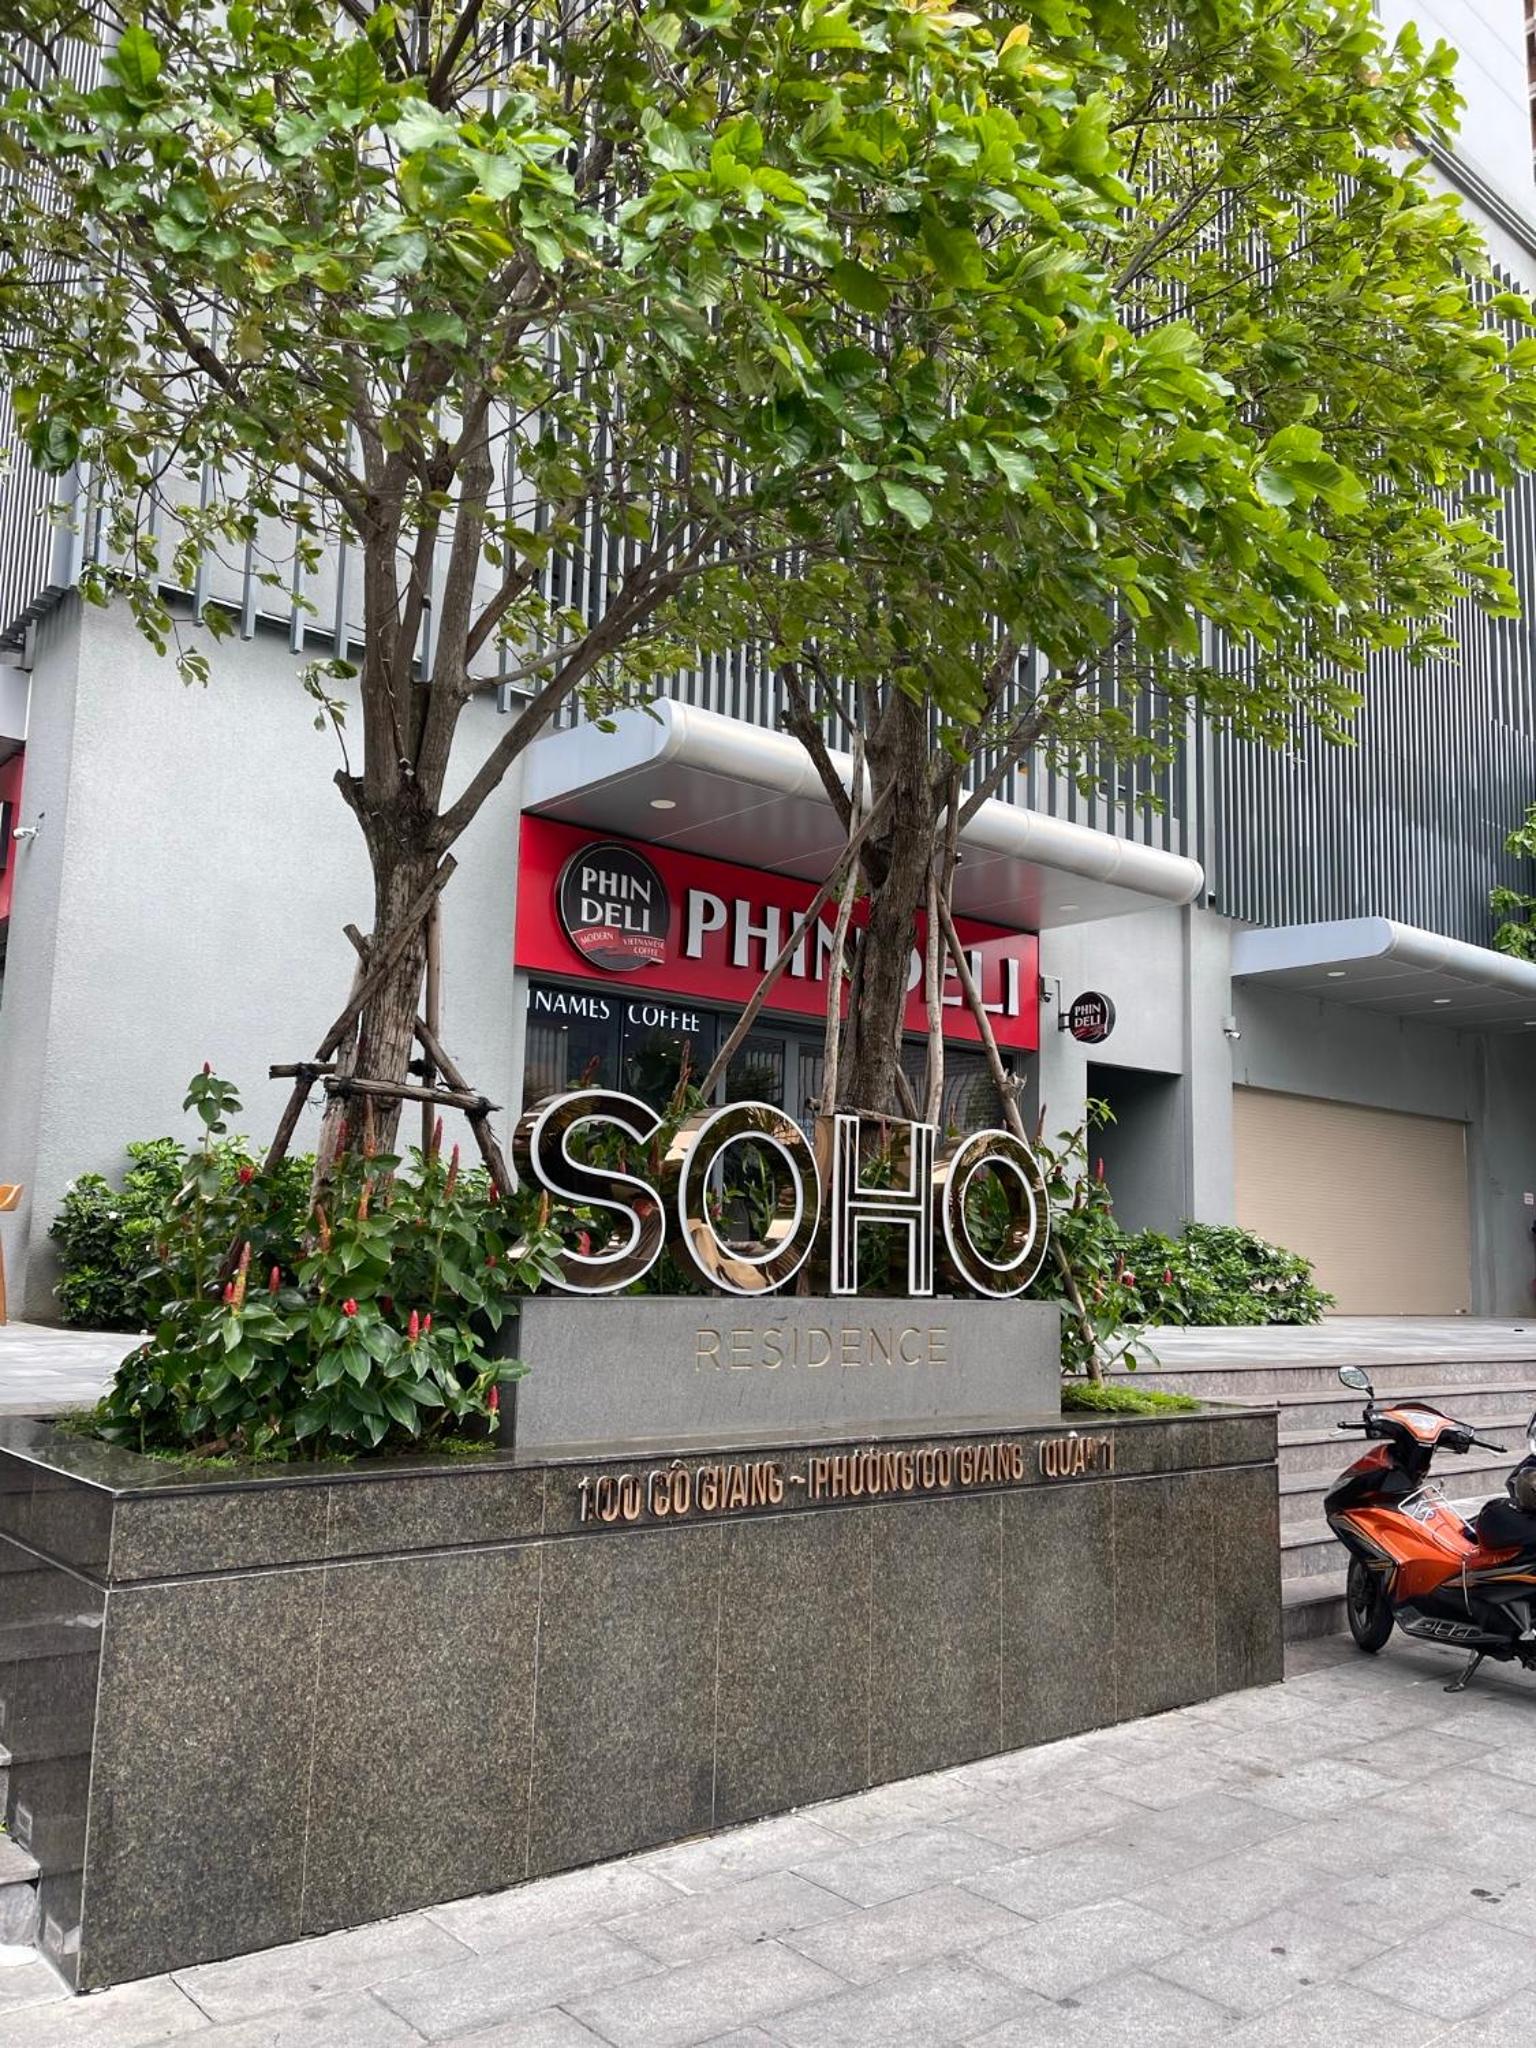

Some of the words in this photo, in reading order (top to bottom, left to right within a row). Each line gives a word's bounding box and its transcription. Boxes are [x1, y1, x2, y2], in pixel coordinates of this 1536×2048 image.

[581, 866, 651, 904] PHIN
[581, 897, 650, 932] DELI
[580, 931, 614, 945] MODERN
[627, 1004, 700, 1032] COFFEE
[1074, 1003, 1101, 1016] PHIN
[1074, 1014, 1100, 1028] DELI
[528, 1088, 1050, 1298] SOHO
[695, 1327, 949, 1372] RESIDENCE
[578, 1474, 642, 1522] 100
[696, 1460, 783, 1511] GIANG
[954, 1442, 1024, 1485] GIANG
